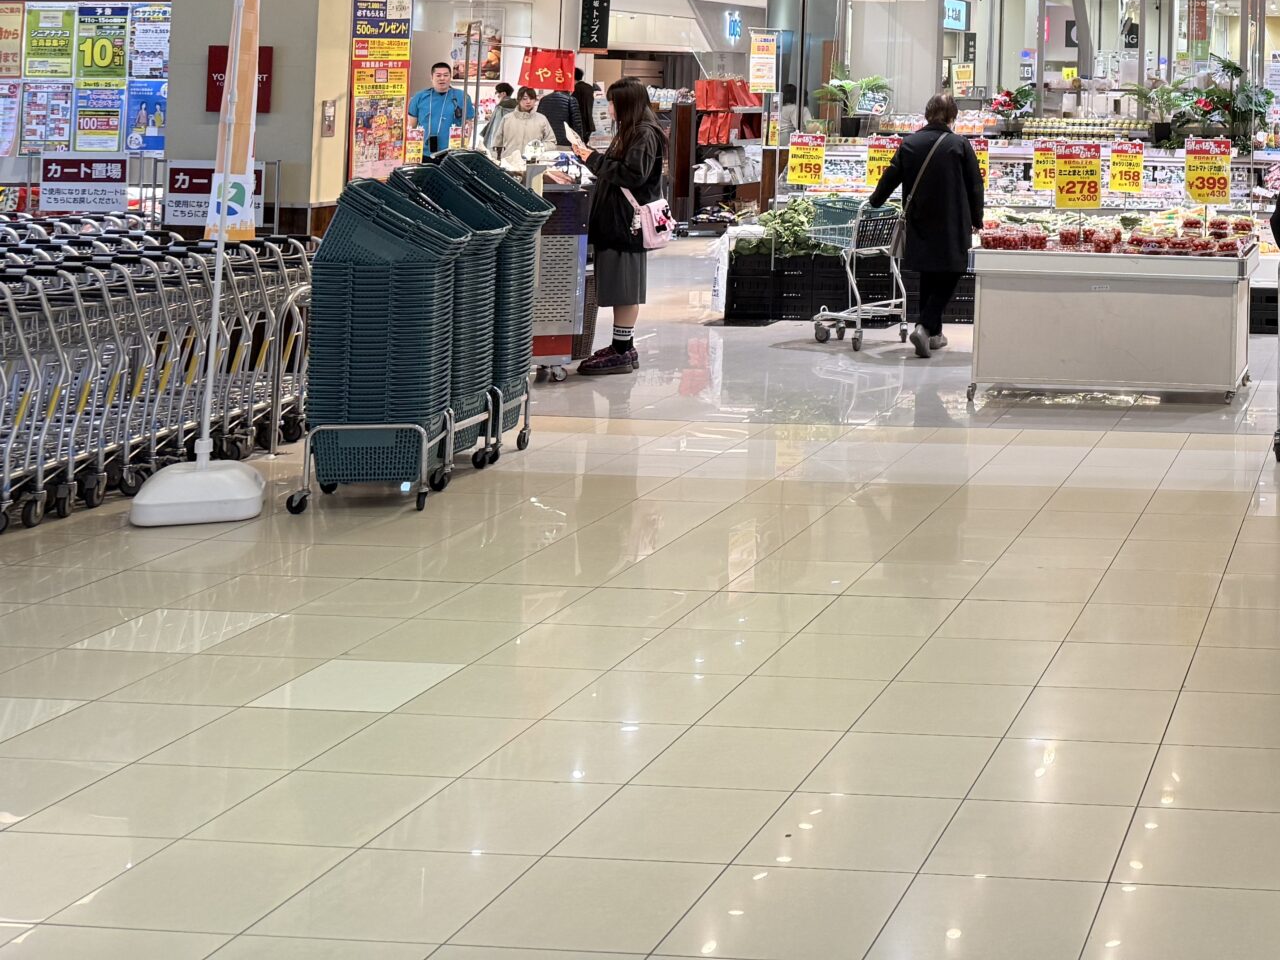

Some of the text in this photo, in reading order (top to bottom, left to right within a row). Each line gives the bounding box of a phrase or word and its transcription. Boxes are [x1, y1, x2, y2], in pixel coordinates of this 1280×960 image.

[79, 117, 97, 130] 100
[47, 163, 122, 180] カート置場
[1035, 167, 1056, 179] ¥15
[1057, 180, 1099, 194] ¥278
[1187, 176, 1228, 190] ¥399
[42, 187, 126, 196] ご使用になりましたカートは
[46, 196, 122, 205] こちらにお戻しください。
